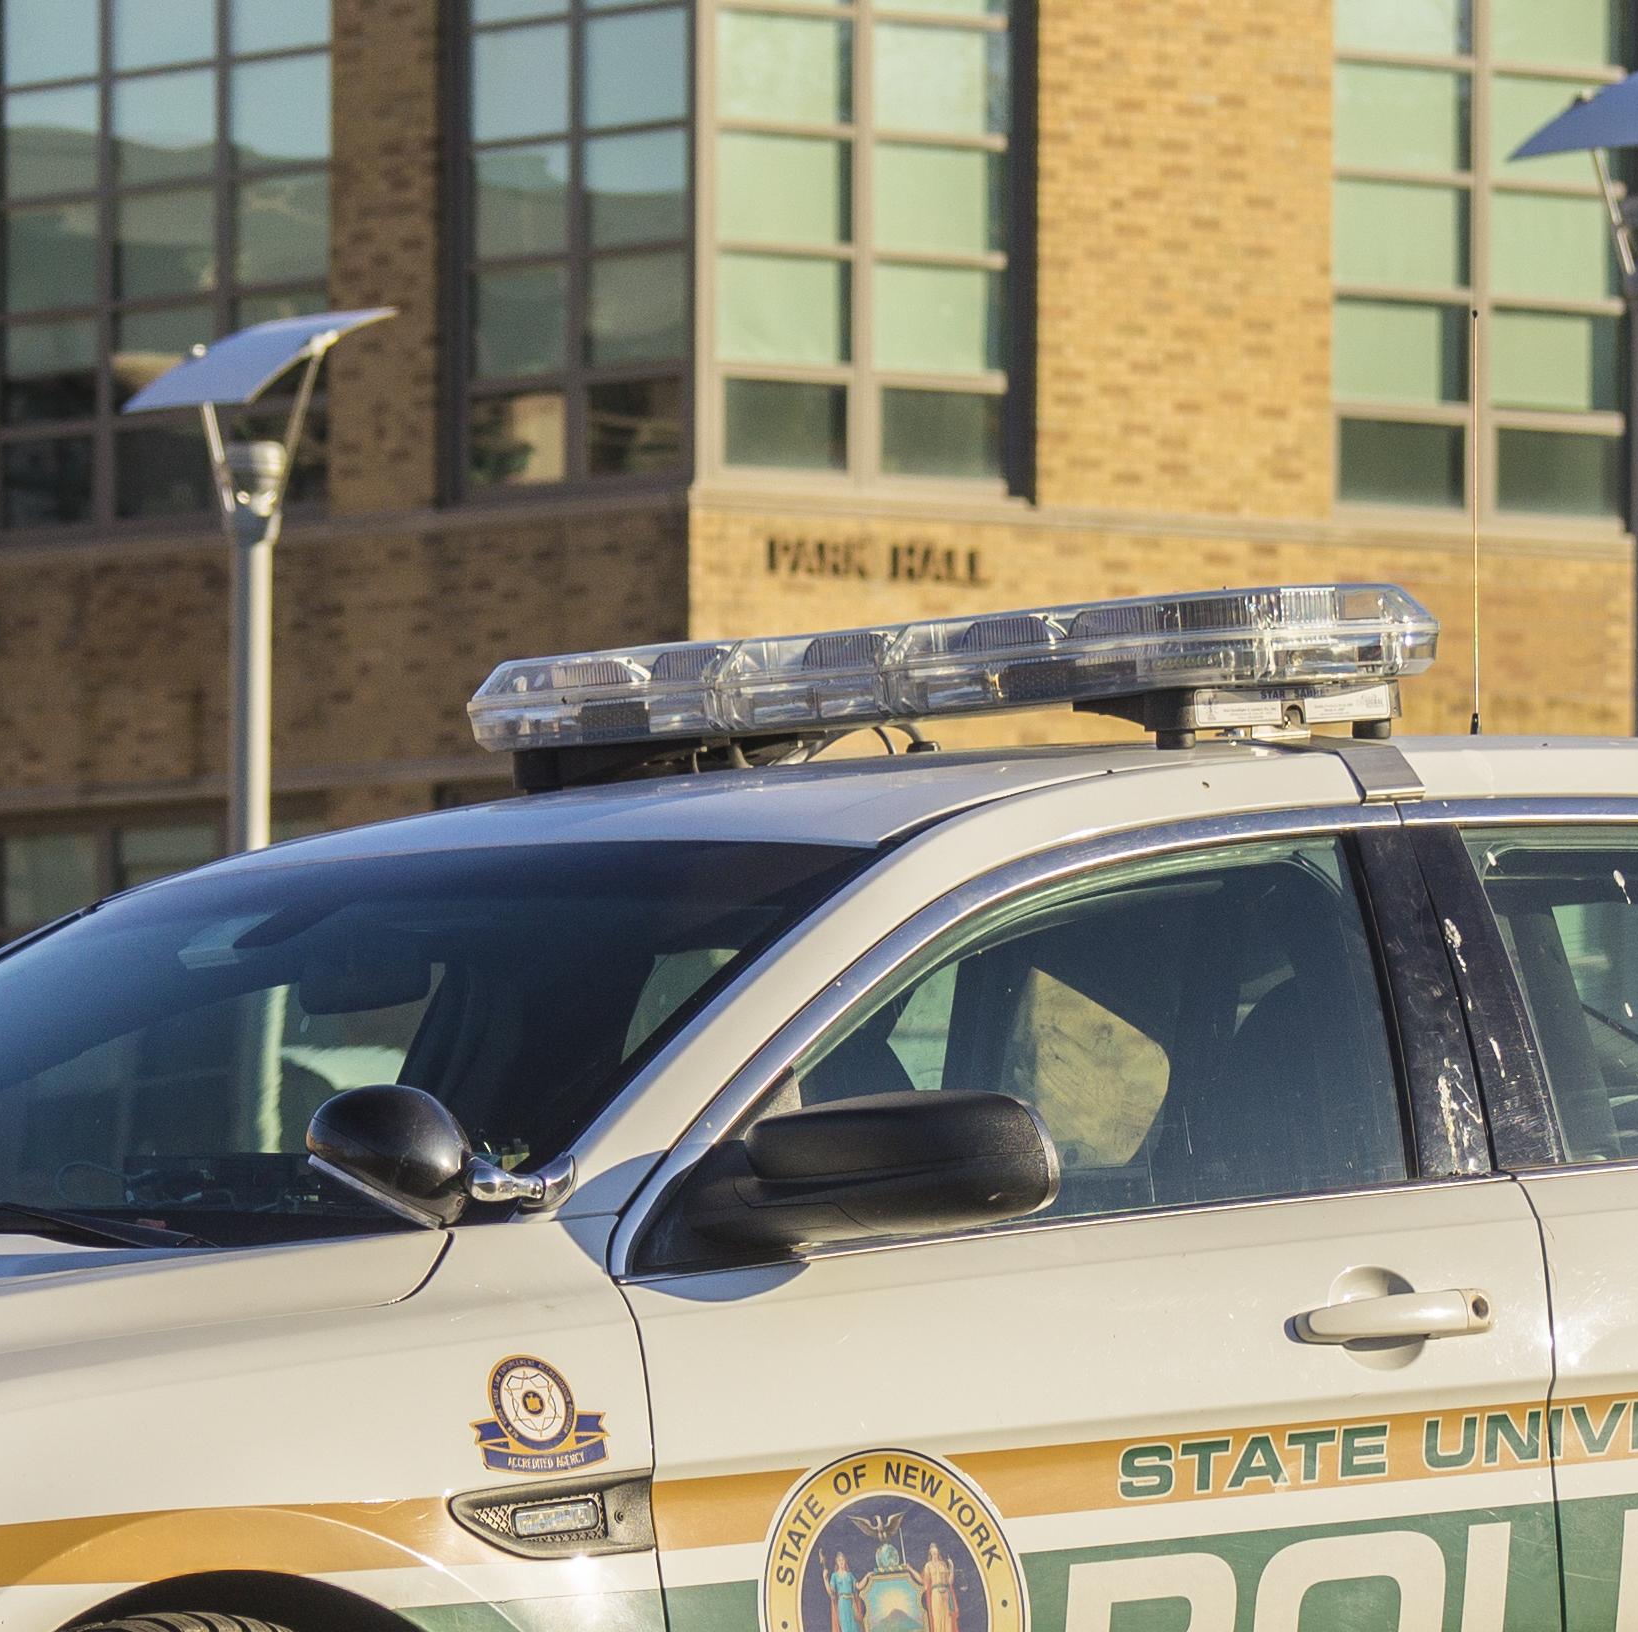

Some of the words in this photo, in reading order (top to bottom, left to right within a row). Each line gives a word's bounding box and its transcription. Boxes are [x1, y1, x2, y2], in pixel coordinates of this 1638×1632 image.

[767, 536, 872, 579] PARK
[890, 541, 988, 588] HALL
[1260, 689, 1285, 699] STAR
[507, 1456, 554, 1470] ACCREDITED
[556, 1451, 585, 1468] AGENCY
[1116, 1420, 1391, 1502] STATE
[776, 1494, 826, 1586] STATE
[832, 1463, 868, 1497] OF
[883, 1461, 943, 1499] NEW
[945, 1488, 1003, 1570] YORK
